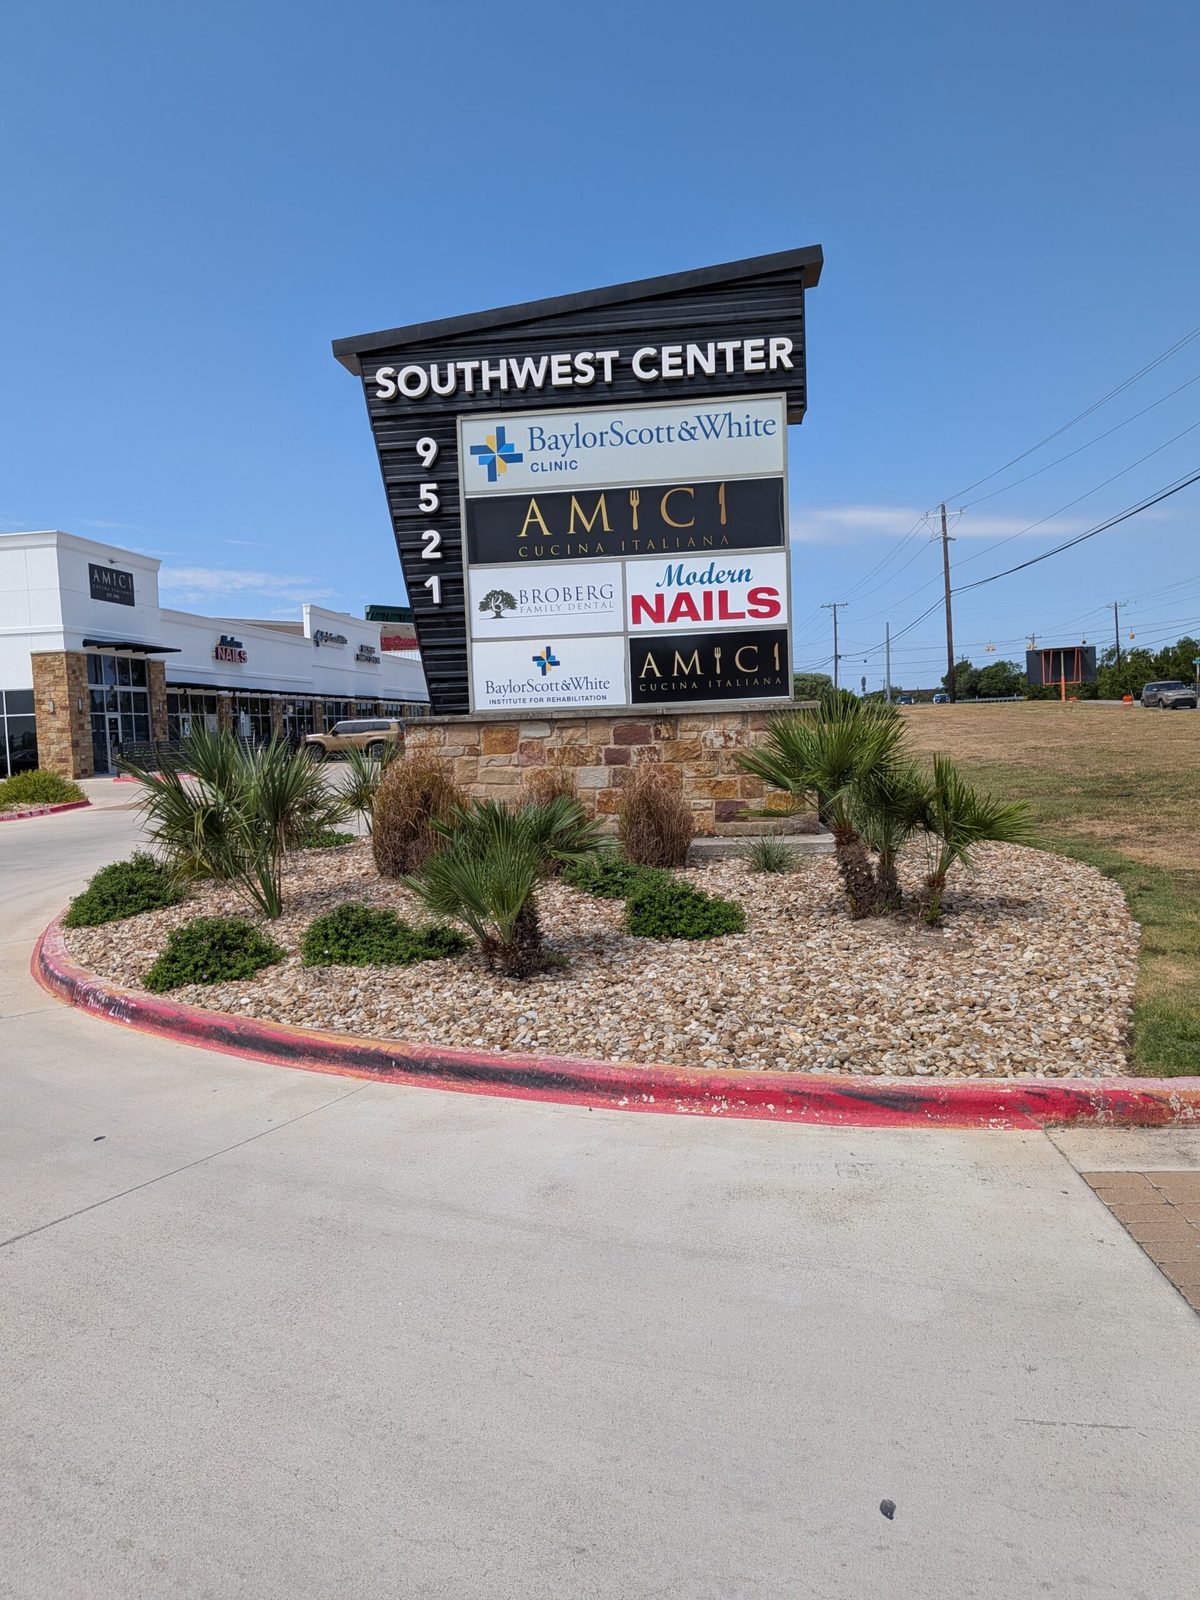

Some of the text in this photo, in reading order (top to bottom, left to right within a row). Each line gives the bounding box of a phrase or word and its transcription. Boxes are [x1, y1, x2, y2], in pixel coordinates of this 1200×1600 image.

[375, 337, 794, 399] SOUTHWEST CENTER
[527, 411, 777, 457] BaylorScott&White
[530, 459, 578, 473] CLINIC
[517, 482, 727, 537] AMICI
[518, 535, 729, 557] CUCINA ITALIANA
[93, 569, 132, 590] AMICI
[656, 562, 753, 588] Modern
[519, 584, 613, 604] BROBERG
[520, 601, 614, 614] FAMILY DENTAL
[631, 586, 782, 625] NAILS
[215, 646, 248, 664] NAILS
[638, 642, 780, 679] AMICI
[485, 676, 610, 697] BaylorScott&White
[639, 676, 782, 692] CUCINA ITALIANA
[489, 694, 607, 705] INSTITUTE FOR REHABILITATION
